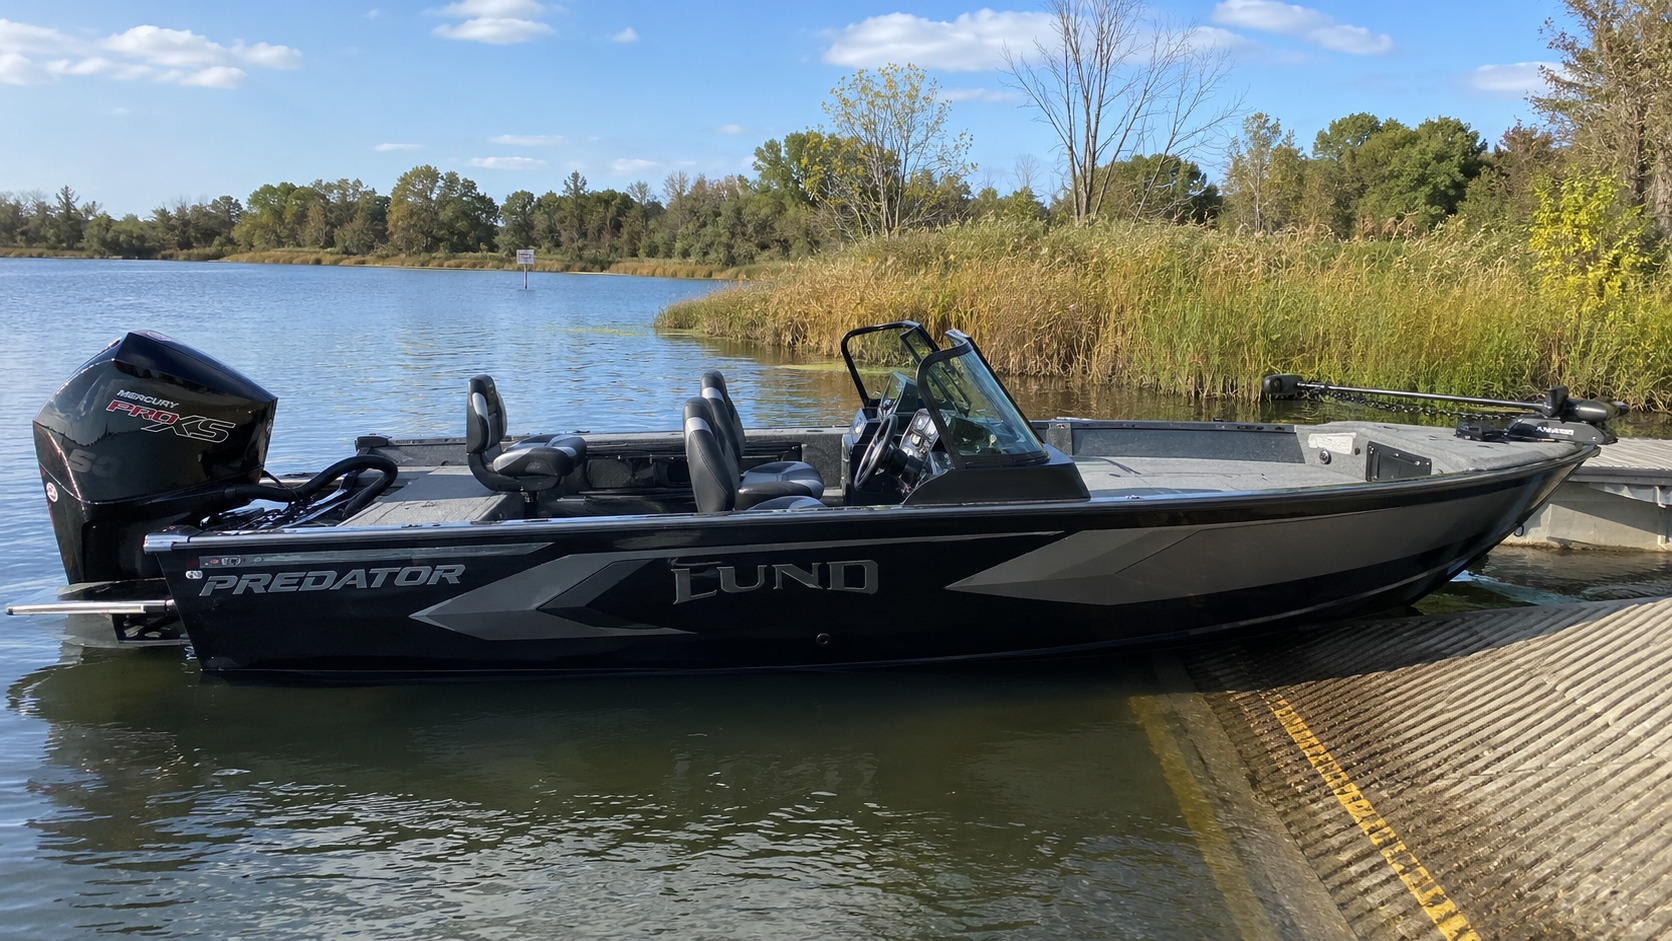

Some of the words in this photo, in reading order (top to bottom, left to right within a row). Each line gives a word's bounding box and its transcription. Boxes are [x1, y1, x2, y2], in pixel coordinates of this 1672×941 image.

[106, 399, 179, 426] PRO
[116, 389, 180, 409] MERCURY
[199, 563, 467, 597] PREDATOR
